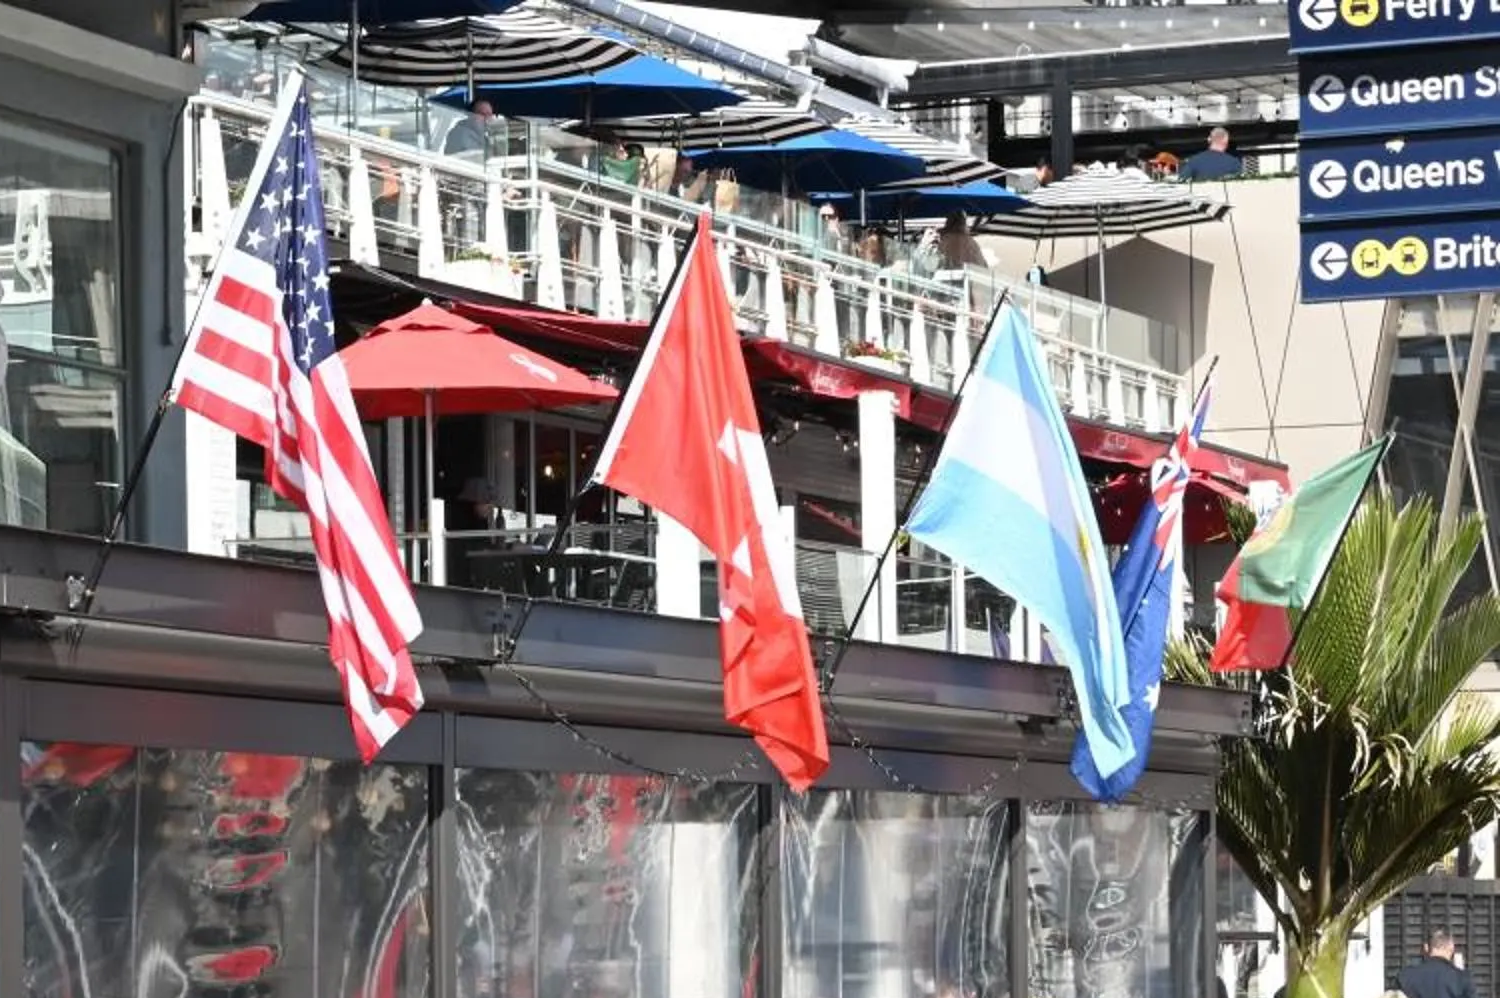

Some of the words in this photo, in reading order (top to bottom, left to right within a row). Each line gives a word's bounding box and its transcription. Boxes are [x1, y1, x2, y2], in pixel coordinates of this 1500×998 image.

[1351, 74, 1464, 106] Queen
[1353, 159, 1484, 193] Queens
[1434, 234, 1500, 271] Brit
